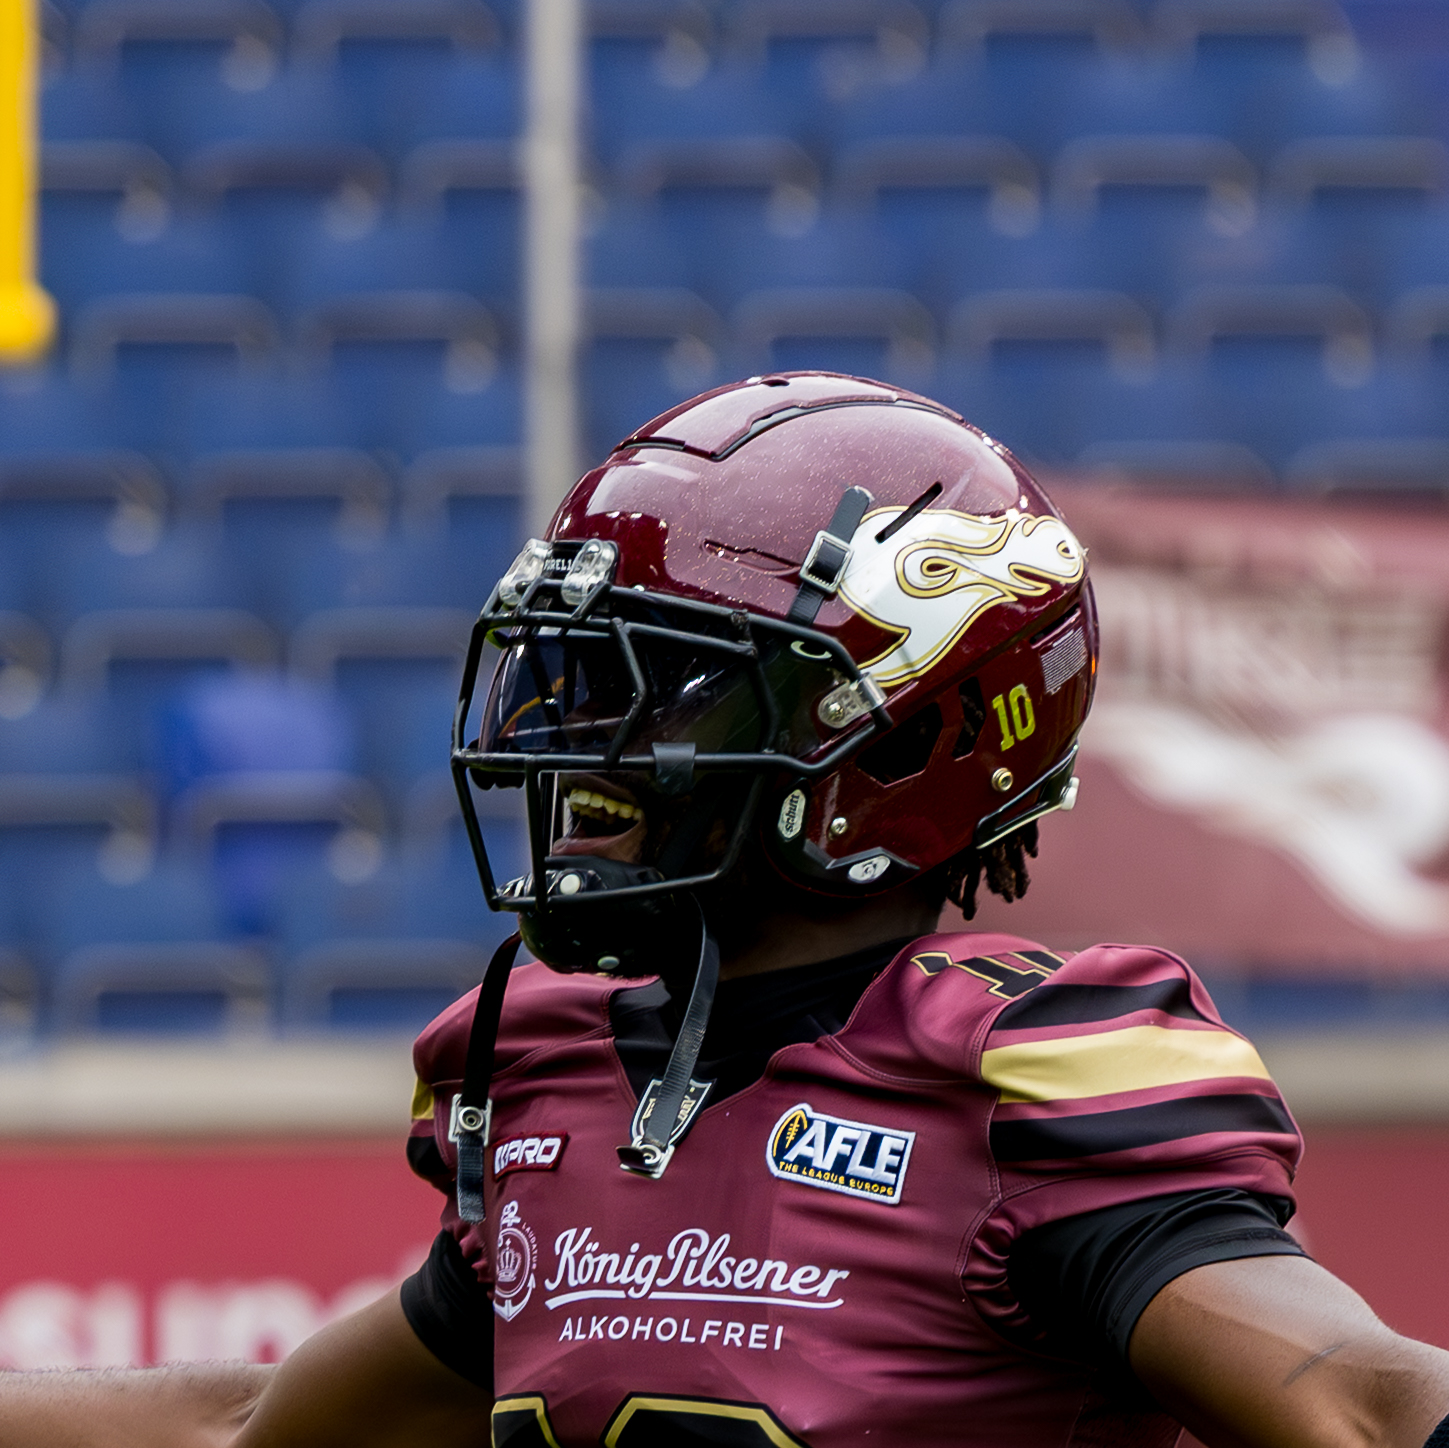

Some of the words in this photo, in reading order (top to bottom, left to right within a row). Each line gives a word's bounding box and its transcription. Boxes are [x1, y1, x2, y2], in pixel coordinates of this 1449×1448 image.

[992, 683, 1036, 752] 10
[778, 1161, 799, 1174] THE
[802, 1166, 845, 1185] LEAGUE
[782, 1119, 906, 1186] AFLE
[544, 1226, 663, 1299] König
[655, 1228, 850, 1298] Pilsener
[558, 1315, 784, 1351] ALKOHOLFREI
